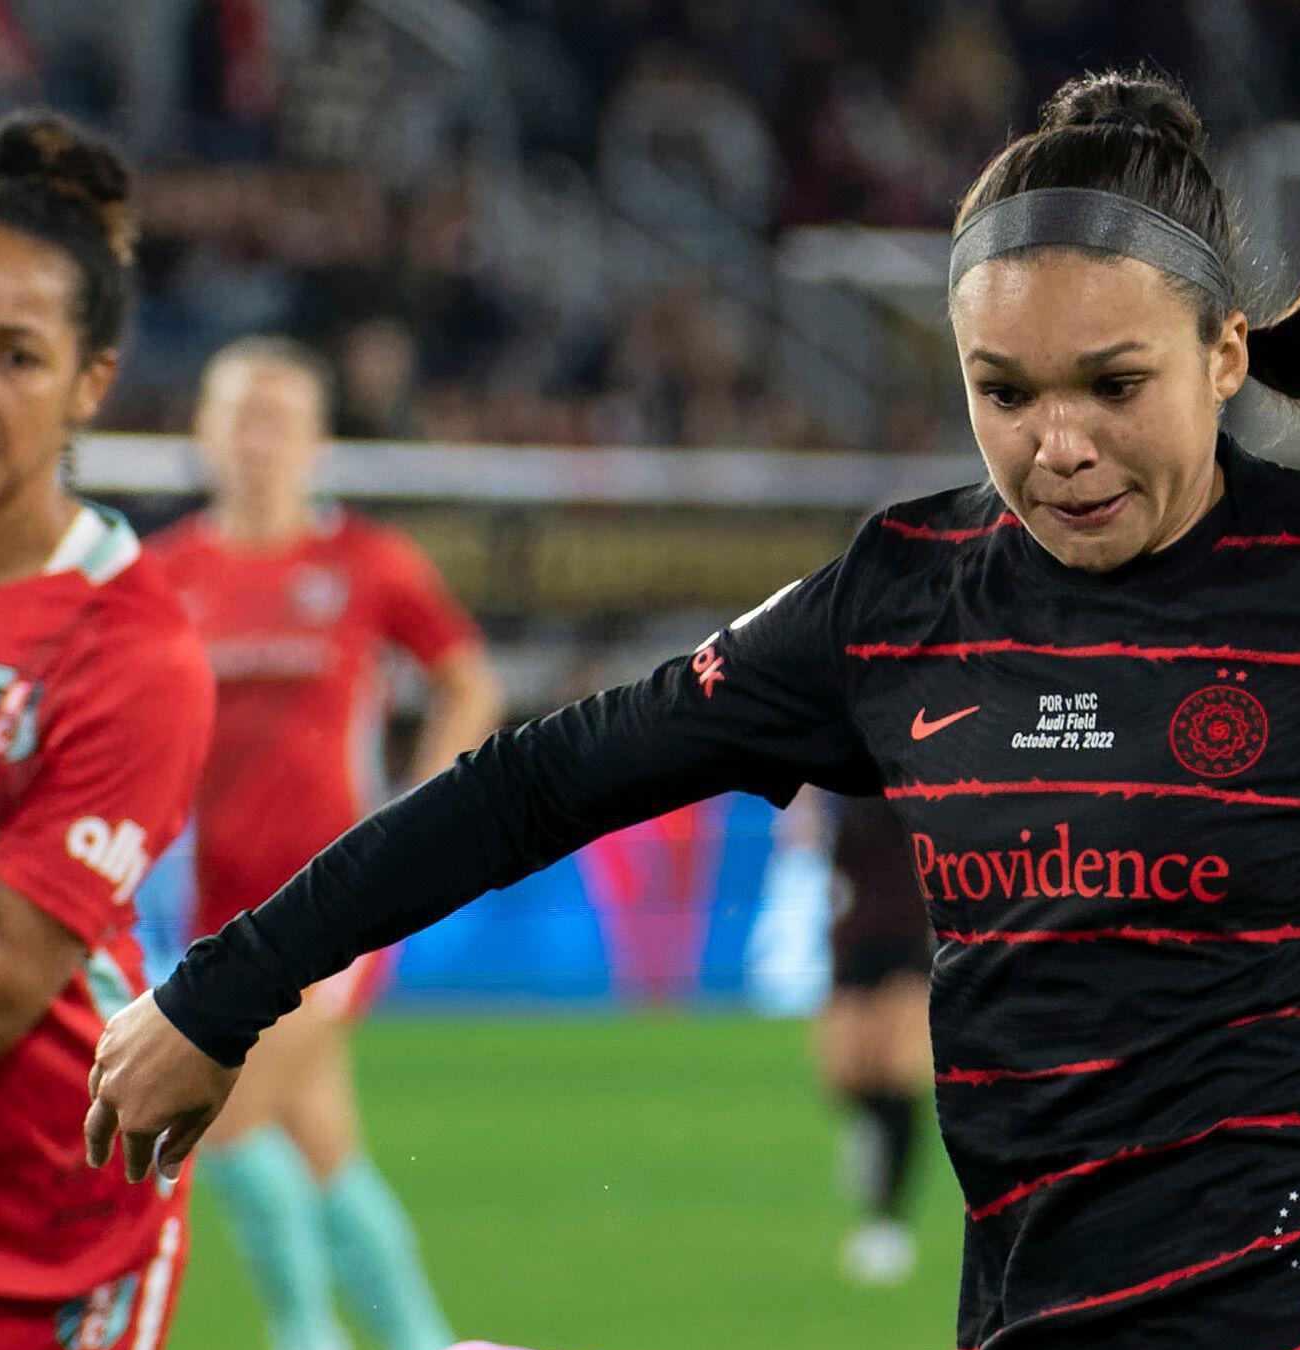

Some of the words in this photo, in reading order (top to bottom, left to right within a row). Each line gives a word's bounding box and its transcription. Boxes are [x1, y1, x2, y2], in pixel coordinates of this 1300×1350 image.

[692, 645, 726, 699] ok
[1039, 694, 1063, 712] POR
[1065, 698, 1073, 711] v
[1074, 692, 1098, 711] KCC
[1036, 713, 1066, 731] Audi
[1066, 712, 1097, 730] Field
[1011, 731, 1061, 749] October
[1061, 731, 1080, 751] 29,
[1082, 731, 1115, 749] 2022
[64, 816, 148, 905] ally
[912, 822, 1230, 903] Providence
